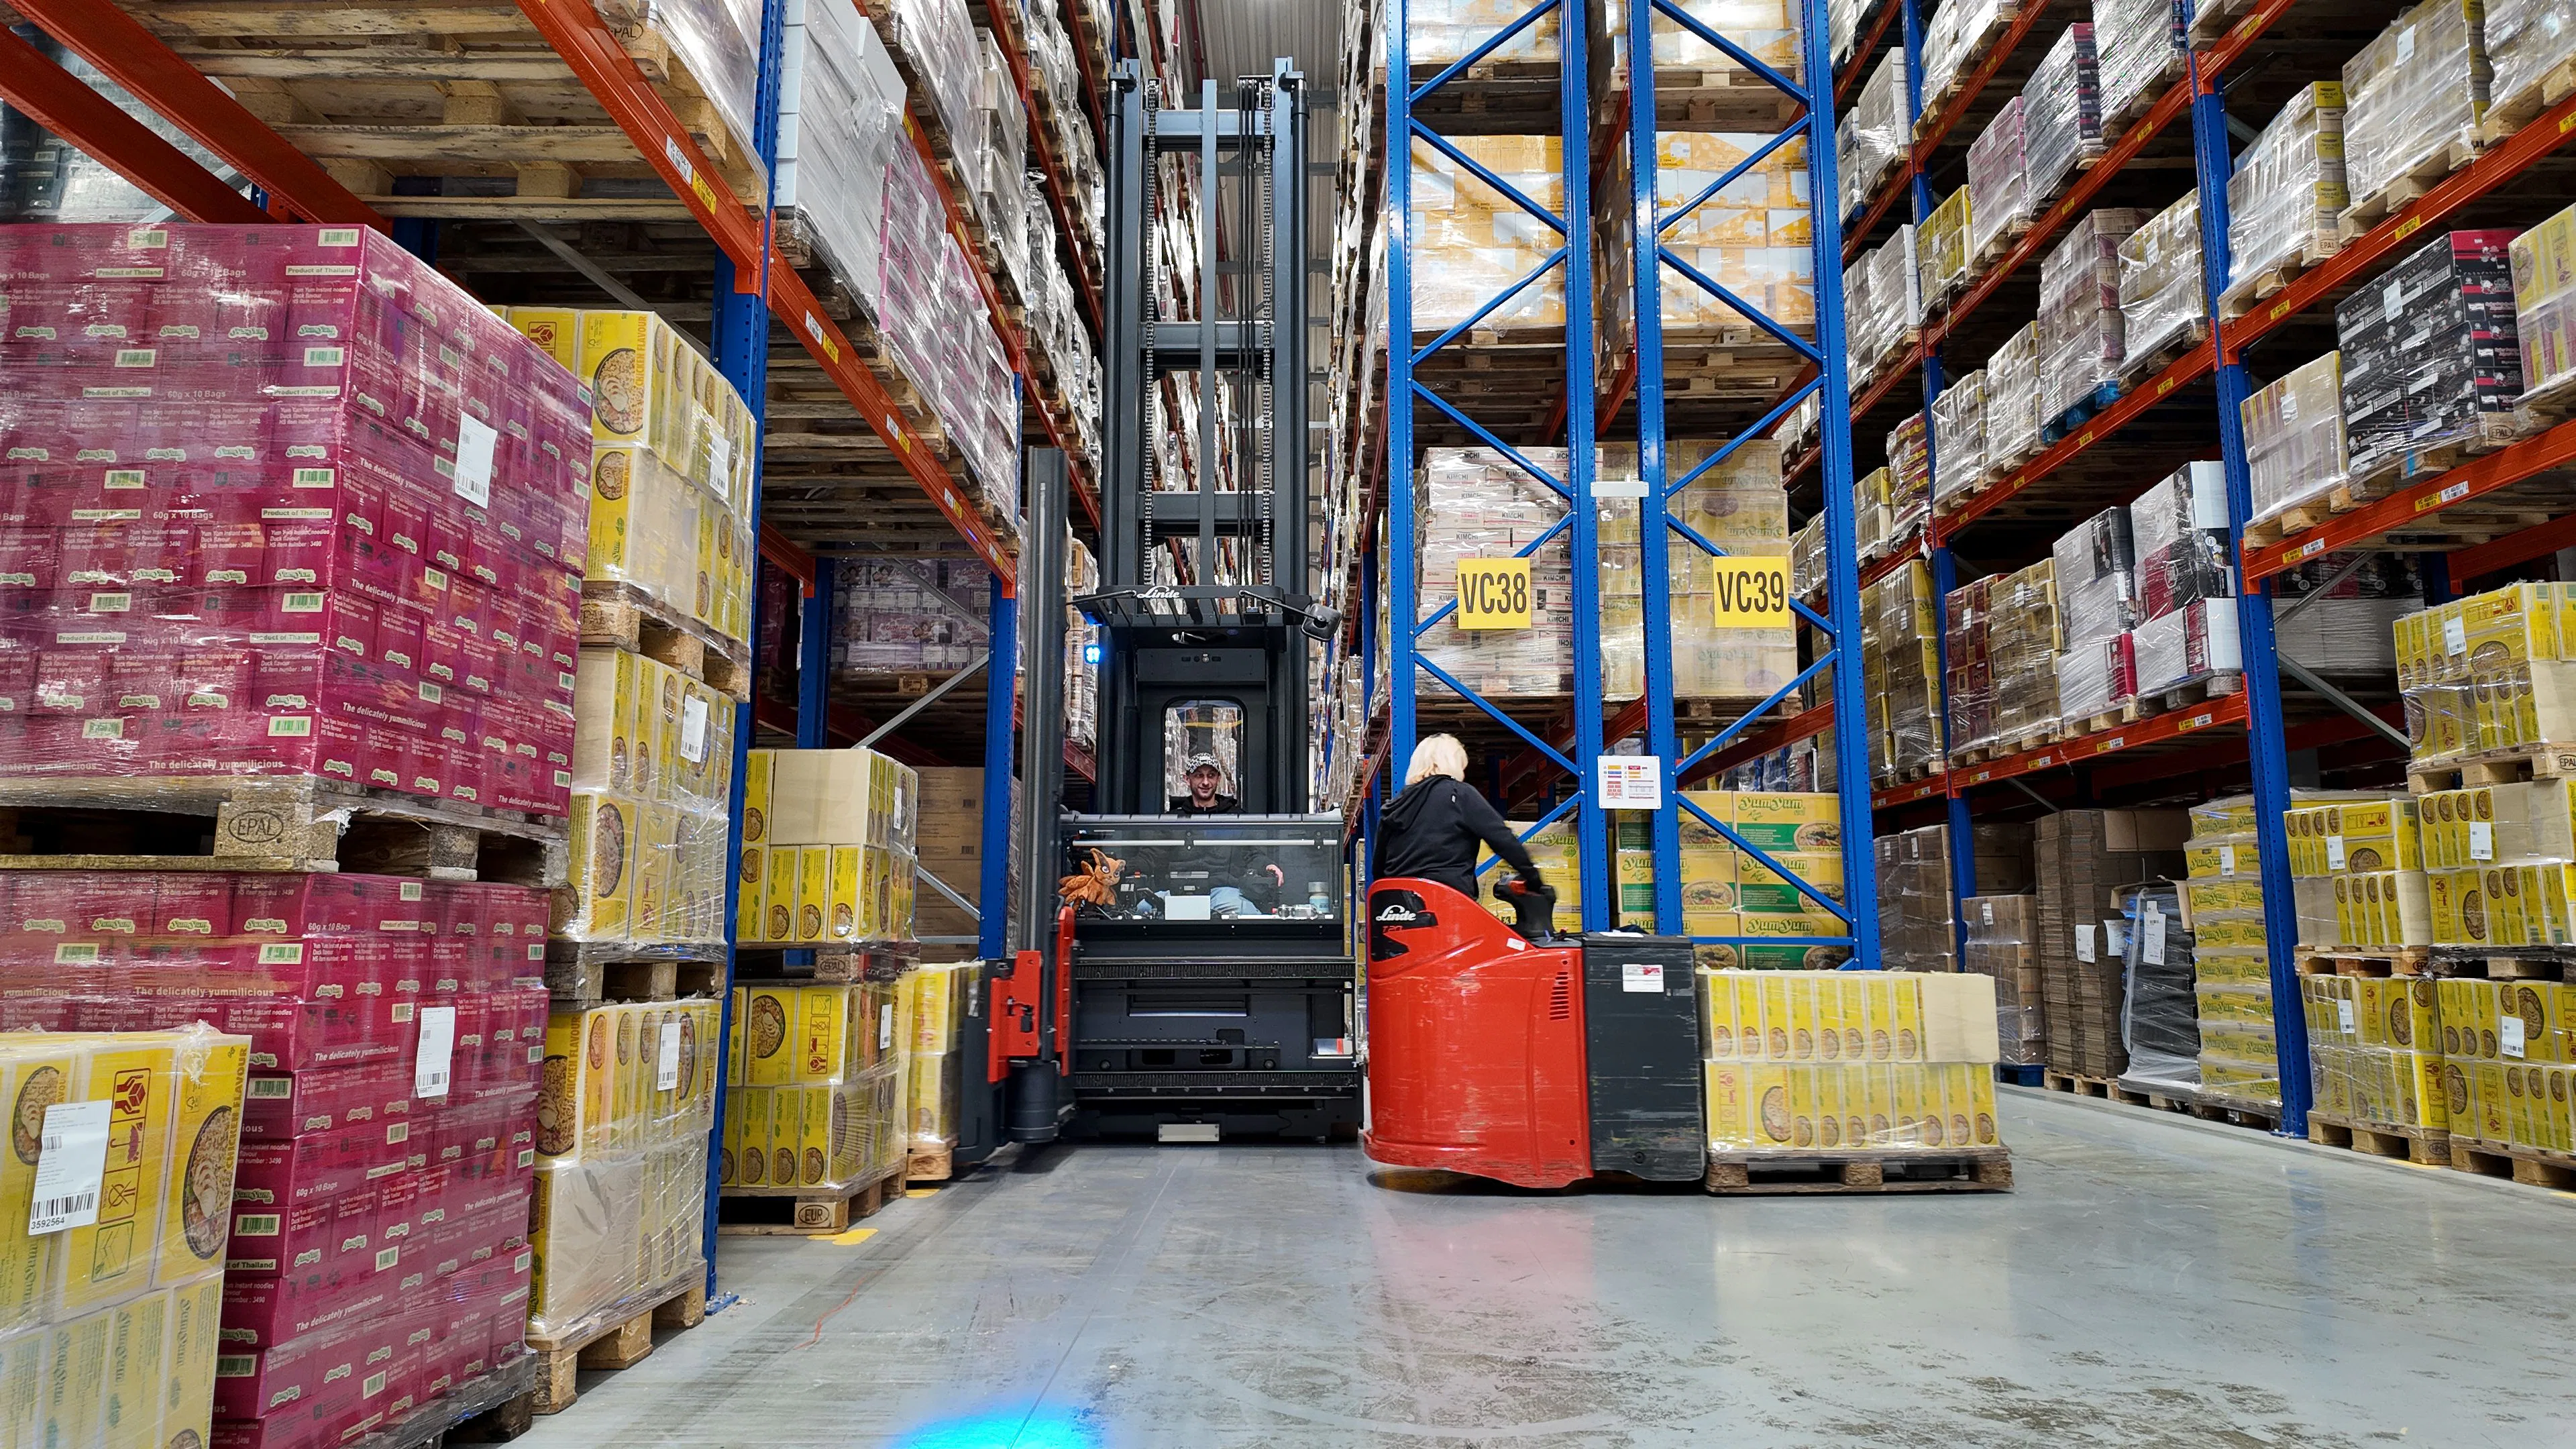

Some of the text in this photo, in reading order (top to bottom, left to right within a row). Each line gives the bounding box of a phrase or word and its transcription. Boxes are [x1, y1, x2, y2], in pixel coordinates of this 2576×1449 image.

[613, 28, 637, 38] PAL
[17, 271, 50, 280] 10 Bags
[181, 268, 246, 278] 60g Bags
[636, 315, 647, 387] CHICKEN FLAVOUR
[167, 390, 184, 398] 60g
[205, 390, 226, 398] Bags
[360, 458, 373, 471] The
[372, 463, 405, 487] delicately
[153, 511, 169, 519] 60g
[192, 511, 214, 519] Bags
[351, 578, 434, 615] The delicately yummilicious
[1136, 586, 1180, 598] Linde
[1461, 573, 1527, 614] VC38
[1717, 571, 1784, 613] VC39
[143, 637, 158, 645] 60g
[343, 702, 427, 729] The delicately yummilicious
[149, 760, 166, 769] The
[219, 759, 283, 769] yummilicious
[498, 794, 508, 803] The
[508, 796, 532, 808] delicately
[1738, 796, 1803, 811] YumYum
[237, 820, 276, 836] EPAL
[1375, 904, 1417, 922] Linde
[308, 922, 321, 931] 60g
[335, 922, 351, 931] Bags
[1746, 919, 1812, 934] YumYum
[135, 986, 274, 998] The delicately yummilicious
[315, 1045, 399, 1062] The delicately yummilicious
[567, 1016, 582, 1099] CHICKEN FLAVOUR
[225, 1047, 248, 1171] CHICKEN FLAVOUR
[296, 1187, 308, 1197] 60g
[323, 1182, 337, 1191] Bags
[804, 1209, 822, 1222] EUR
[31, 1217, 65, 1230] 3592564
[297, 1293, 384, 1332] The delicately yummilicious
